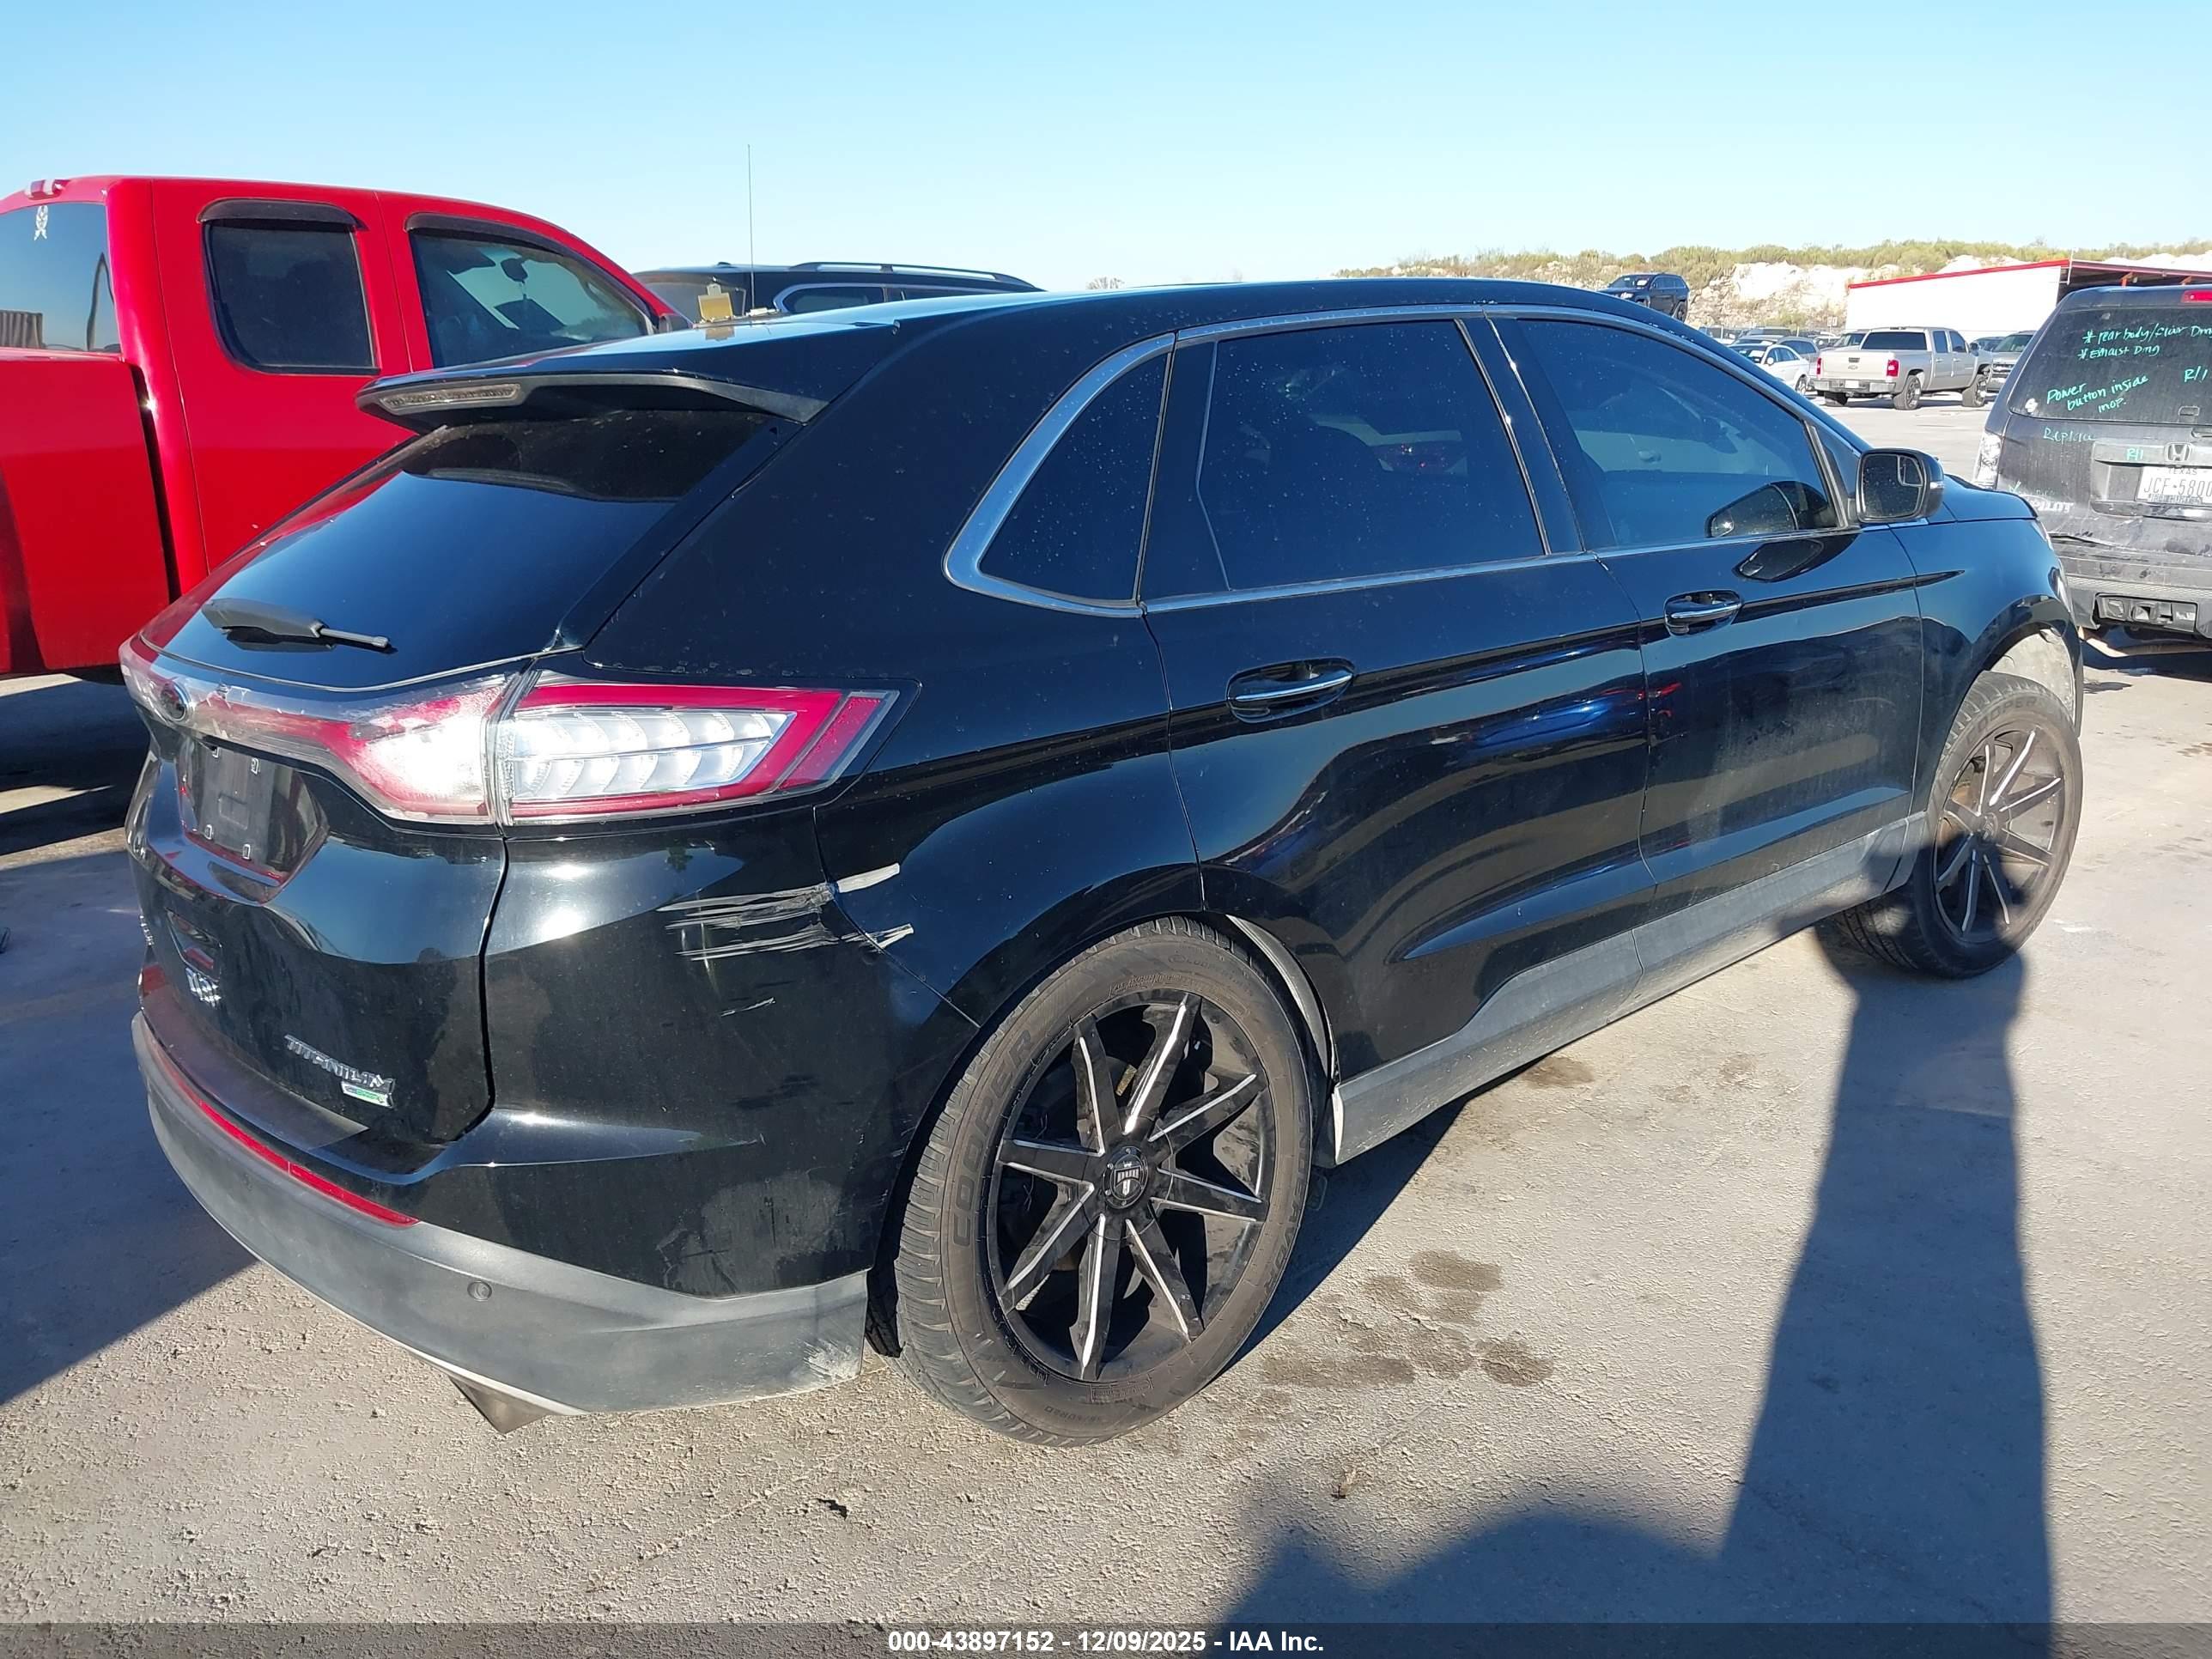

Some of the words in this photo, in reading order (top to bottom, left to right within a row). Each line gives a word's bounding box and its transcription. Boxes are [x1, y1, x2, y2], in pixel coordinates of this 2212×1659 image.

[2134, 344, 2160, 357] Dmg
[2046, 383, 2087, 404] Power
[2067, 388, 2106, 410] button
[2111, 375, 2148, 394] inside
[2168, 467, 2197, 476] TEXAS
[953, 1029, 1030, 1248] COOPER
